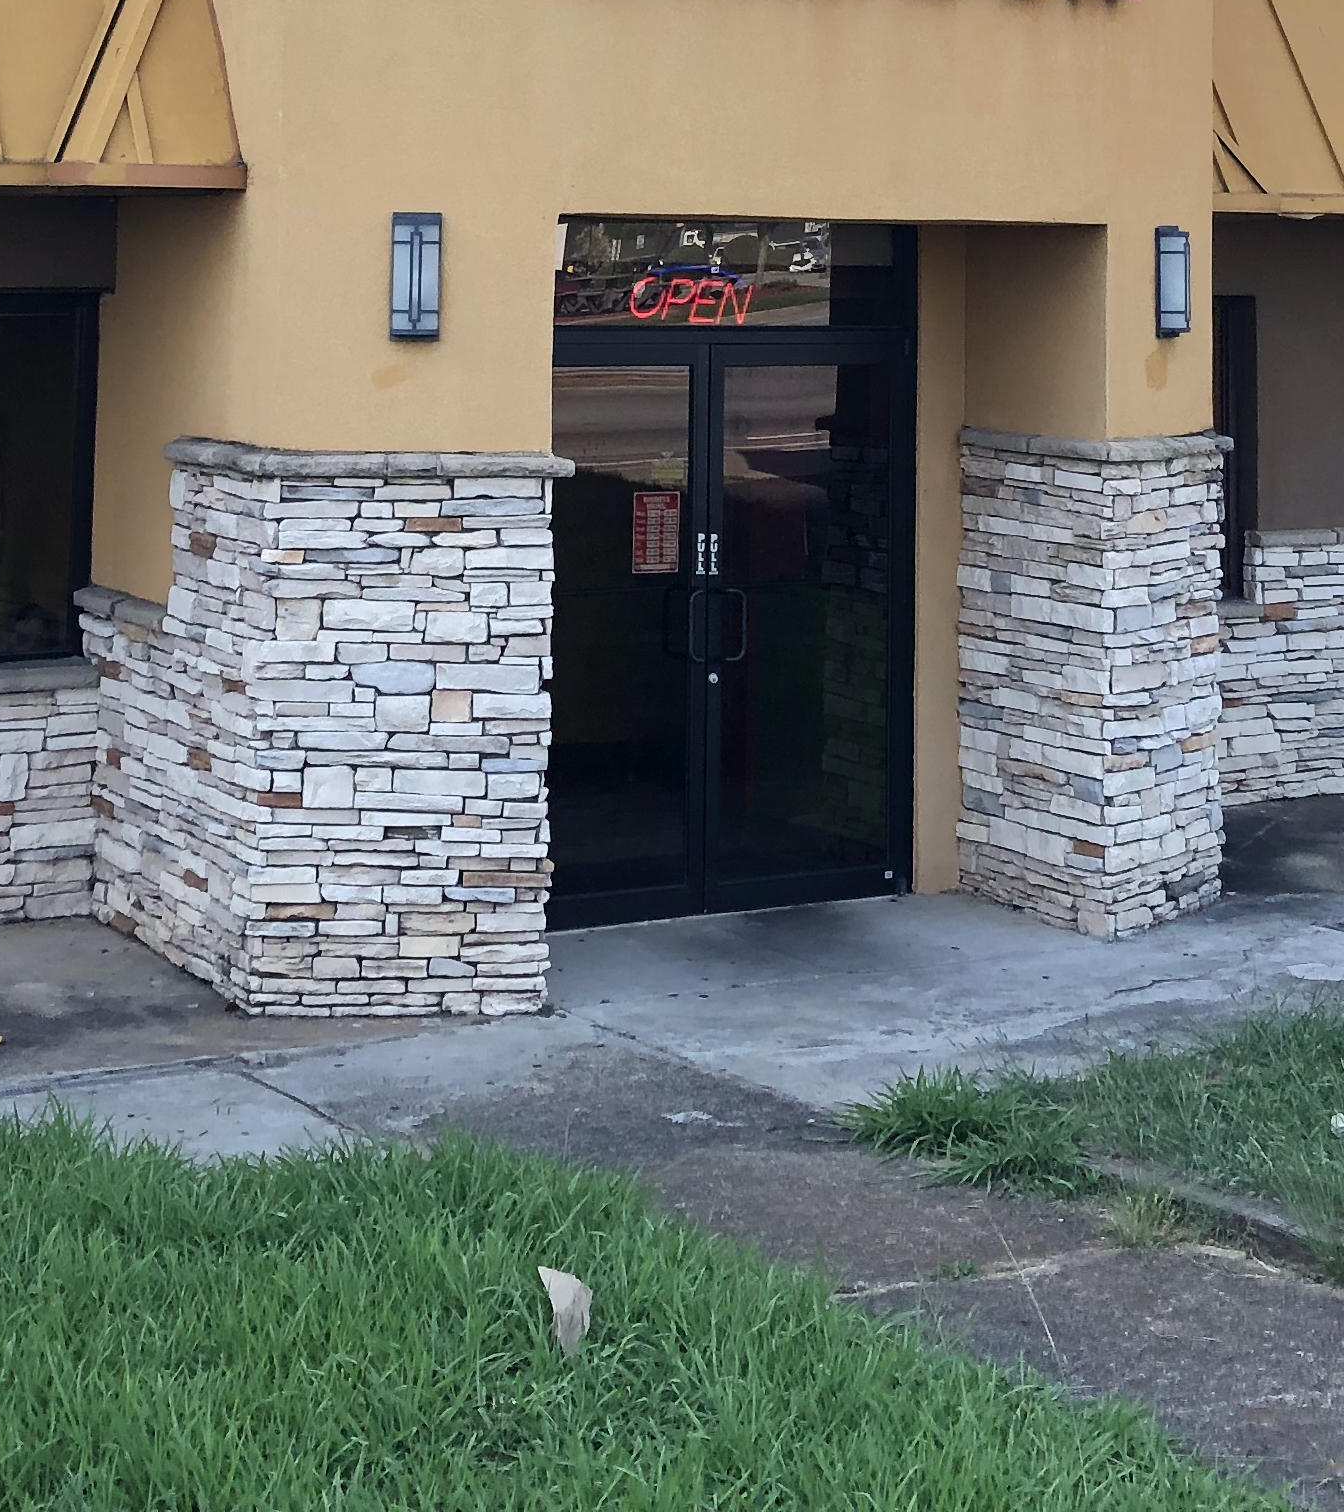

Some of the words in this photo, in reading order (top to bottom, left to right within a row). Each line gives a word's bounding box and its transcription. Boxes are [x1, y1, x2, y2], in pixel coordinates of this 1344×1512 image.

[629, 276, 754, 326] OPEN
[696, 533, 706, 575] PULL
[709, 533, 719, 575] PULL
